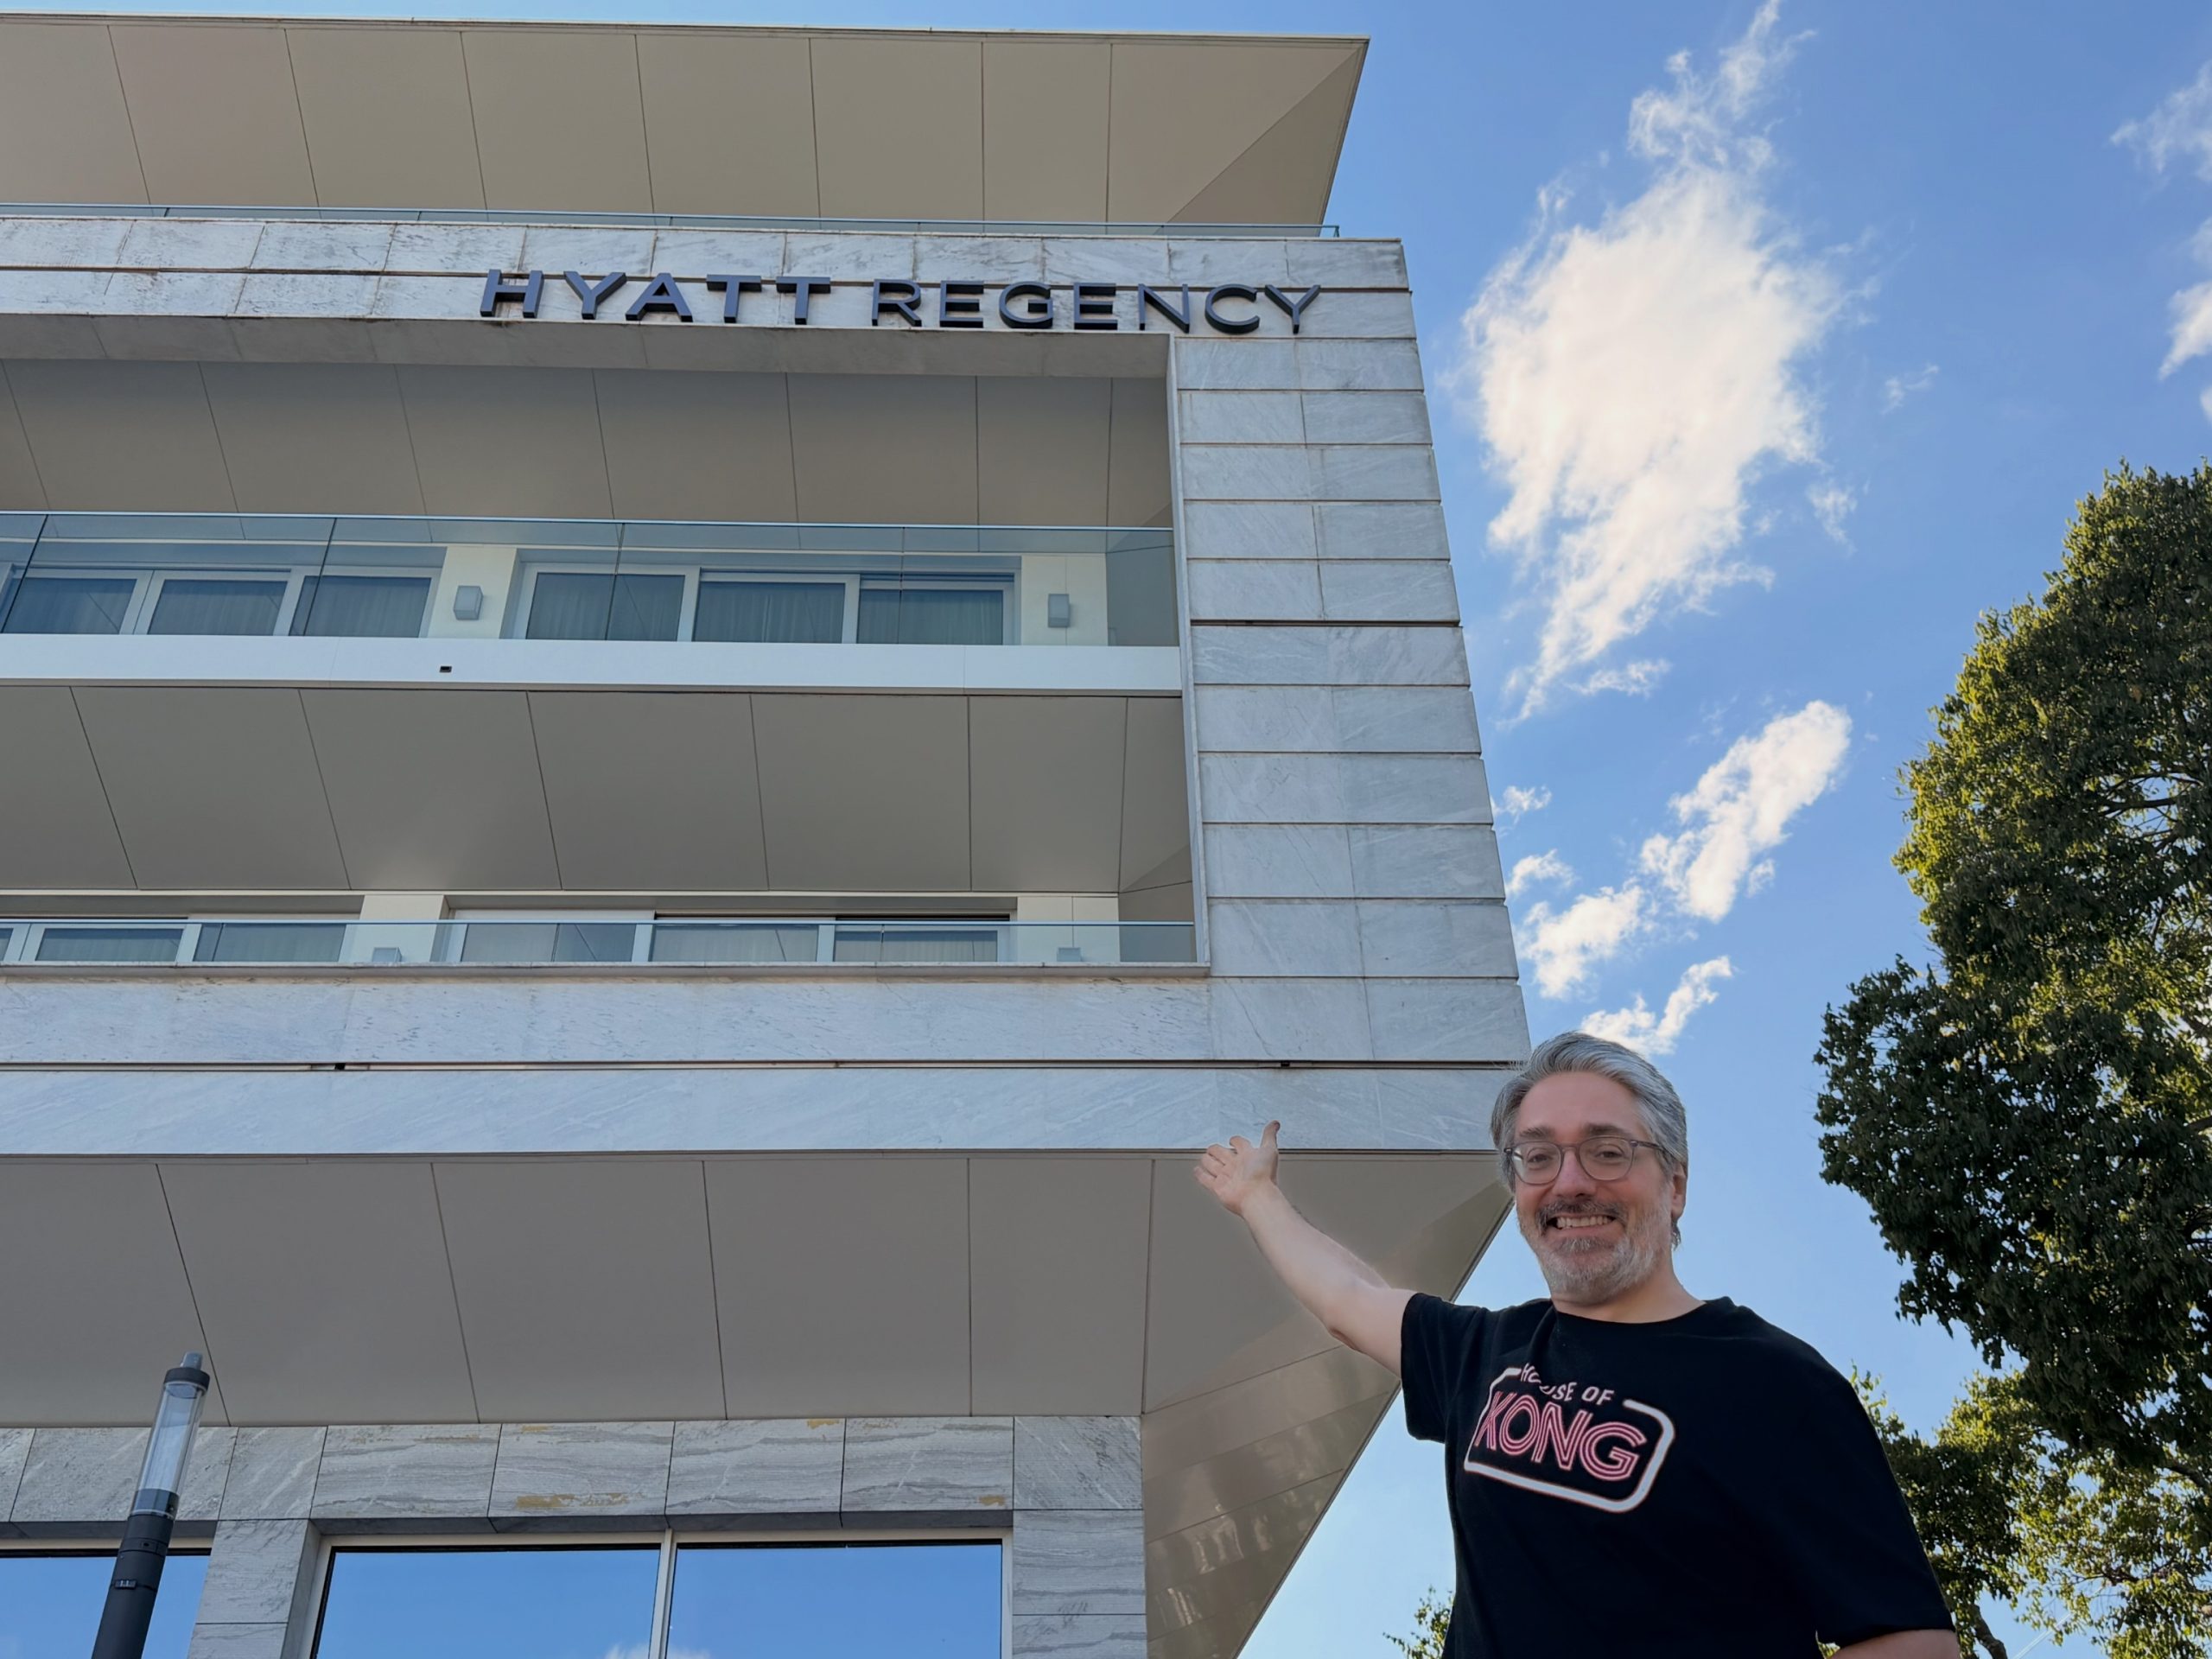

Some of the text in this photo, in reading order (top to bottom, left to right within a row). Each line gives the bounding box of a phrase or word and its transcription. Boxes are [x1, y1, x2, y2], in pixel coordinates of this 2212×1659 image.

[480, 269, 1321, 334] HYATT REGENCY
[1581, 1386, 1615, 1405] OF
[1474, 1390, 1647, 1481] KONG
